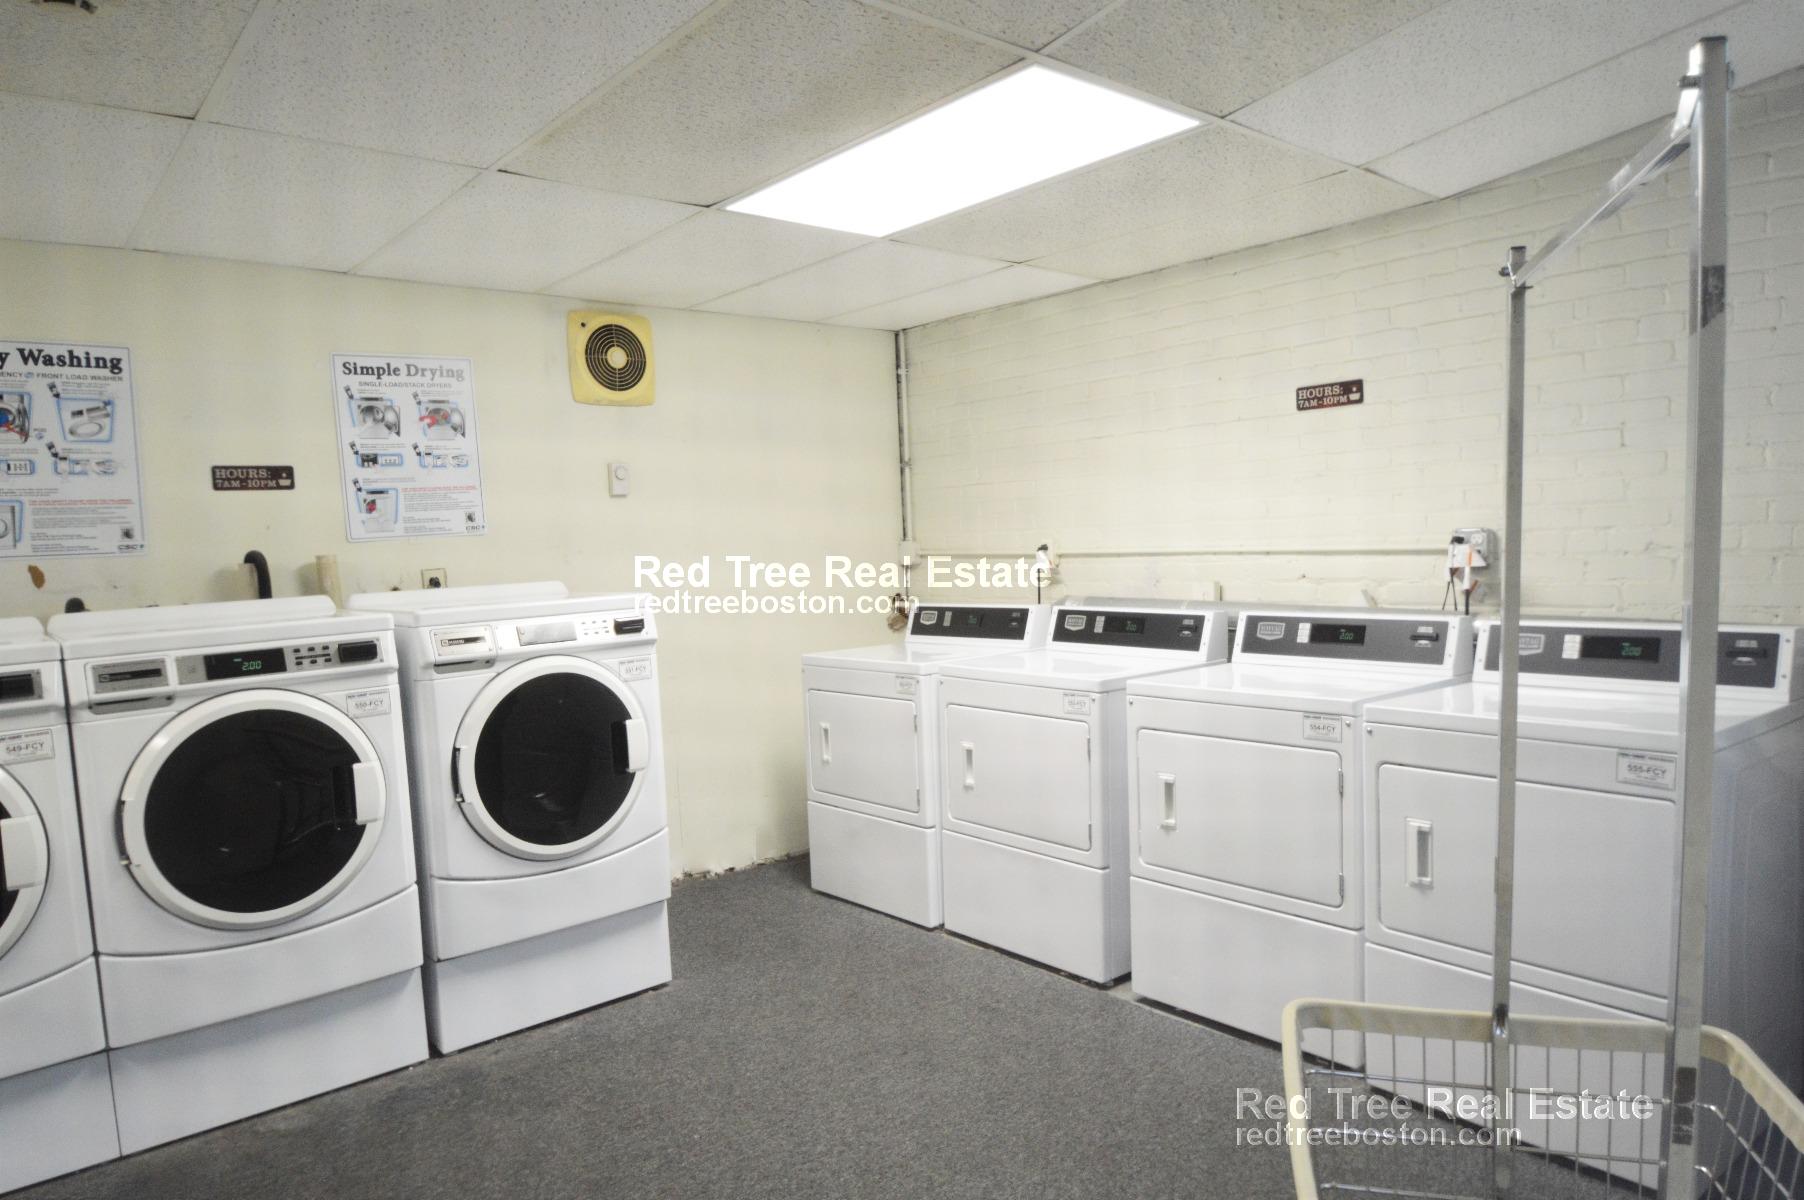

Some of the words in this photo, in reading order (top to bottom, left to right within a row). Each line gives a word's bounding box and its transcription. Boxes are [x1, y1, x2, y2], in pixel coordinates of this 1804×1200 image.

[16, 347, 123, 375] Washing
[342, 361, 401, 380] Simple
[405, 363, 465, 382] Drying
[1298, 385, 1344, 400] HOURS:
[215, 468, 272, 478] HOURS:
